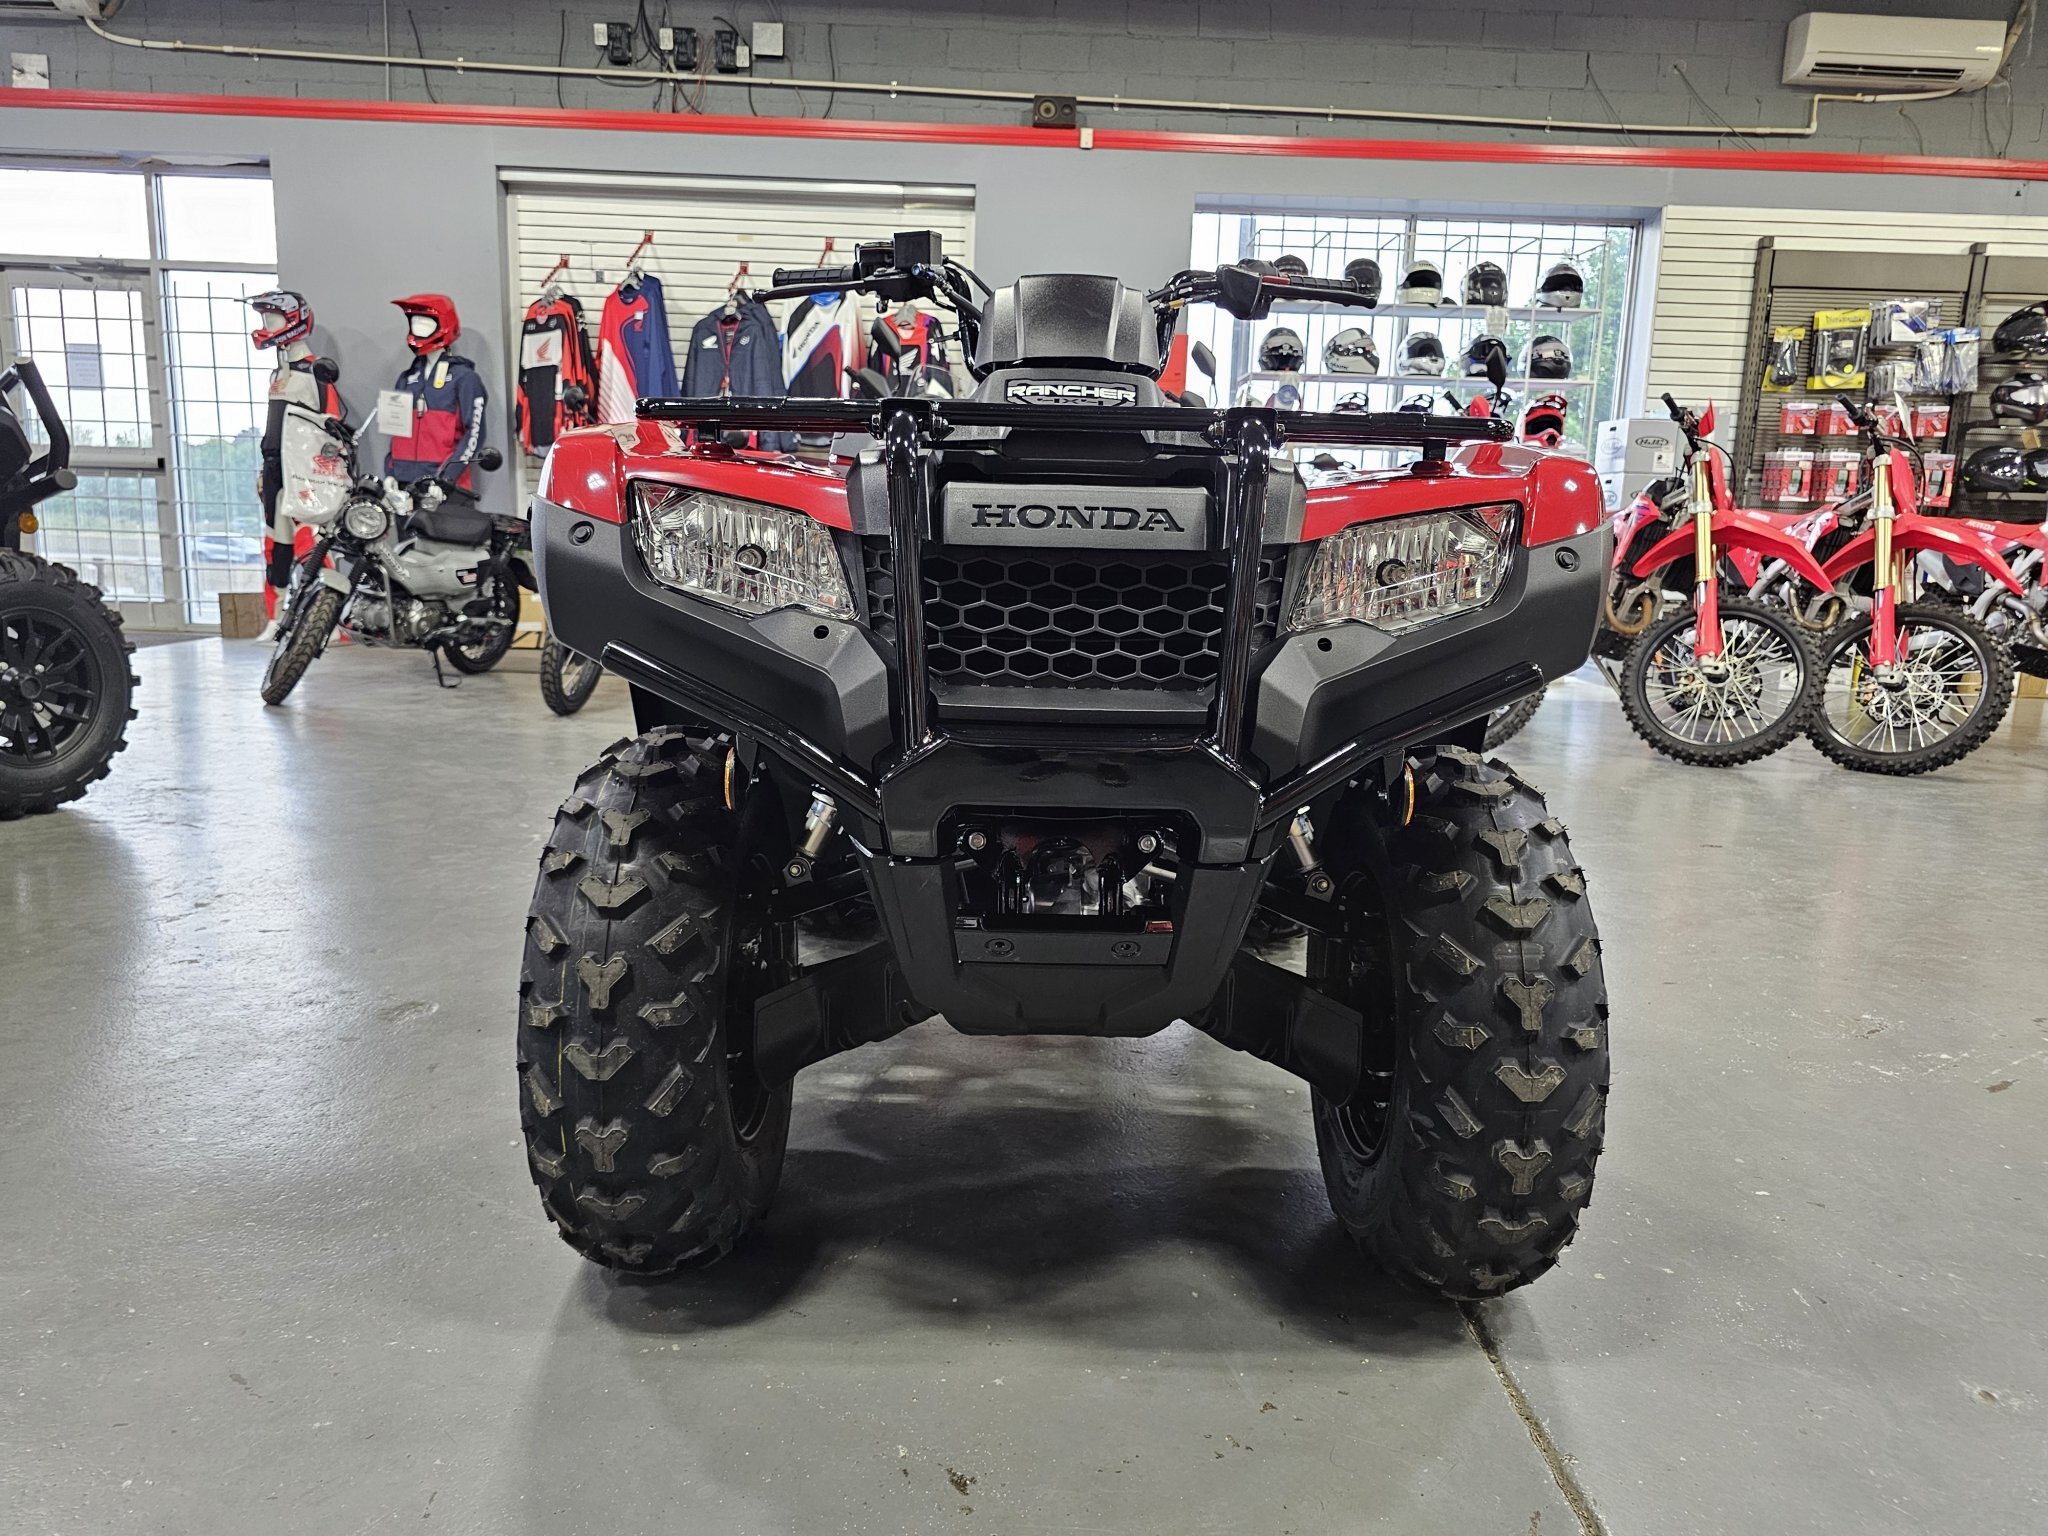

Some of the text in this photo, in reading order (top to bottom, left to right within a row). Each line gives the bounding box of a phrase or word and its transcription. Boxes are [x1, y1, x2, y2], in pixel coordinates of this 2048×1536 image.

[1007, 385, 1136, 402] RANCHER
[459, 396, 485, 464] HONDA
[971, 504, 1185, 533] HONDA
[1965, 519, 1997, 533] HONDA
